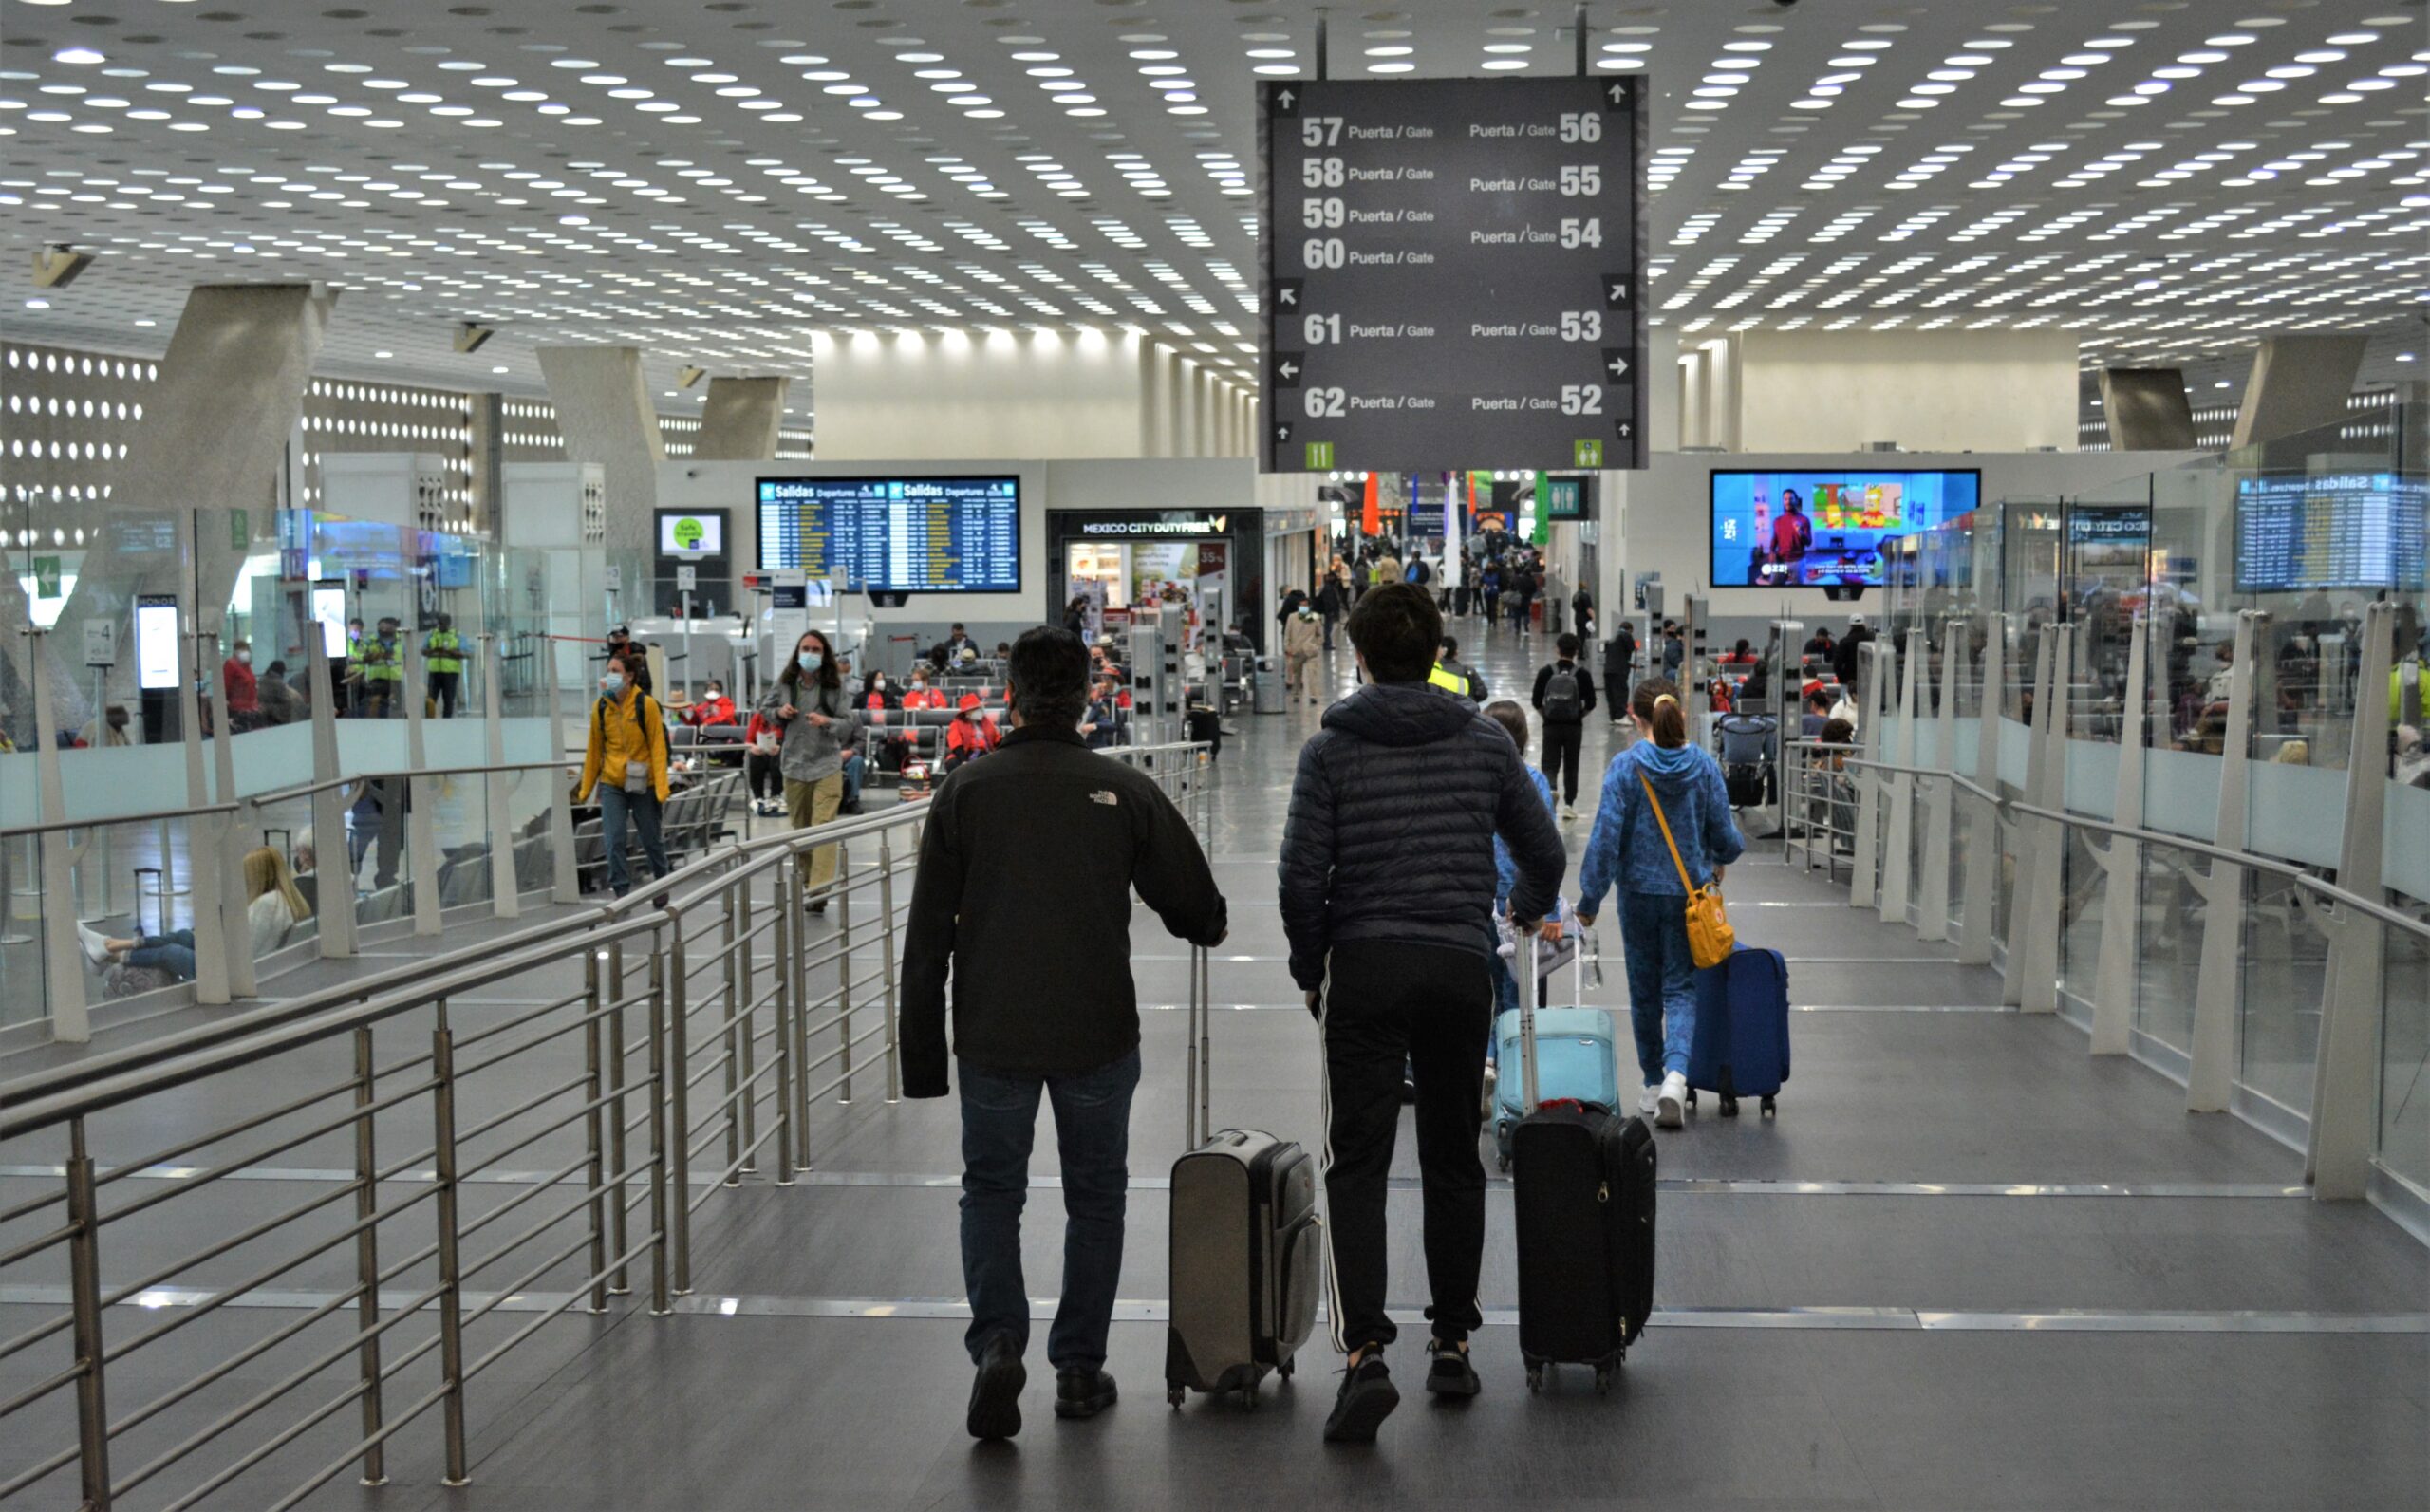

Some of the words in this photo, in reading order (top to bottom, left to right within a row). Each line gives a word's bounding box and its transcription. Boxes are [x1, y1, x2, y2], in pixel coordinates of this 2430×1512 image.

[1303, 117, 1343, 147] 57
[1348, 124, 1393, 139] Puerta
[1406, 125, 1434, 139] Gate
[1469, 123, 1516, 138] Puerta
[1527, 124, 1557, 138] Gate
[1560, 113, 1601, 143] 56
[1303, 158, 1344, 188] 58
[1349, 166, 1394, 180] Puerta
[1407, 167, 1435, 180] Gate
[1469, 177, 1516, 192] Puerta
[1527, 178, 1557, 192] Gate
[1561, 165, 1601, 196] 55
[1304, 197, 1344, 228] 59
[1349, 208, 1394, 223] Puerta
[1407, 209, 1435, 223] Gate
[1470, 230, 1517, 244] Puerta
[1528, 231, 1558, 244] Gate
[1561, 218, 1602, 249] 54
[1304, 238, 1344, 269] 60
[1349, 250, 1394, 265] Puerta
[1407, 251, 1435, 265] Gate
[1304, 313, 1341, 345] 61
[1349, 323, 1394, 337] Puerta
[1407, 324, 1435, 337] Gate
[1471, 322, 1518, 337] Puerta
[1529, 323, 1559, 337] Gate
[1561, 310, 1601, 342] 53
[1305, 387, 1345, 418] 62
[1350, 395, 1395, 409] Puerta
[1408, 396, 1436, 409] Gate
[1471, 396, 1518, 411] Puerta
[1529, 397, 1559, 411] Gate
[1561, 384, 1602, 415] 52
[776, 484, 814, 498] Salidas
[904, 483, 944, 497] Salidas
[1083, 523, 1127, 533] MEXICO
[139, 597, 176, 606] HONOR
[101, 624, 110, 641] 4
